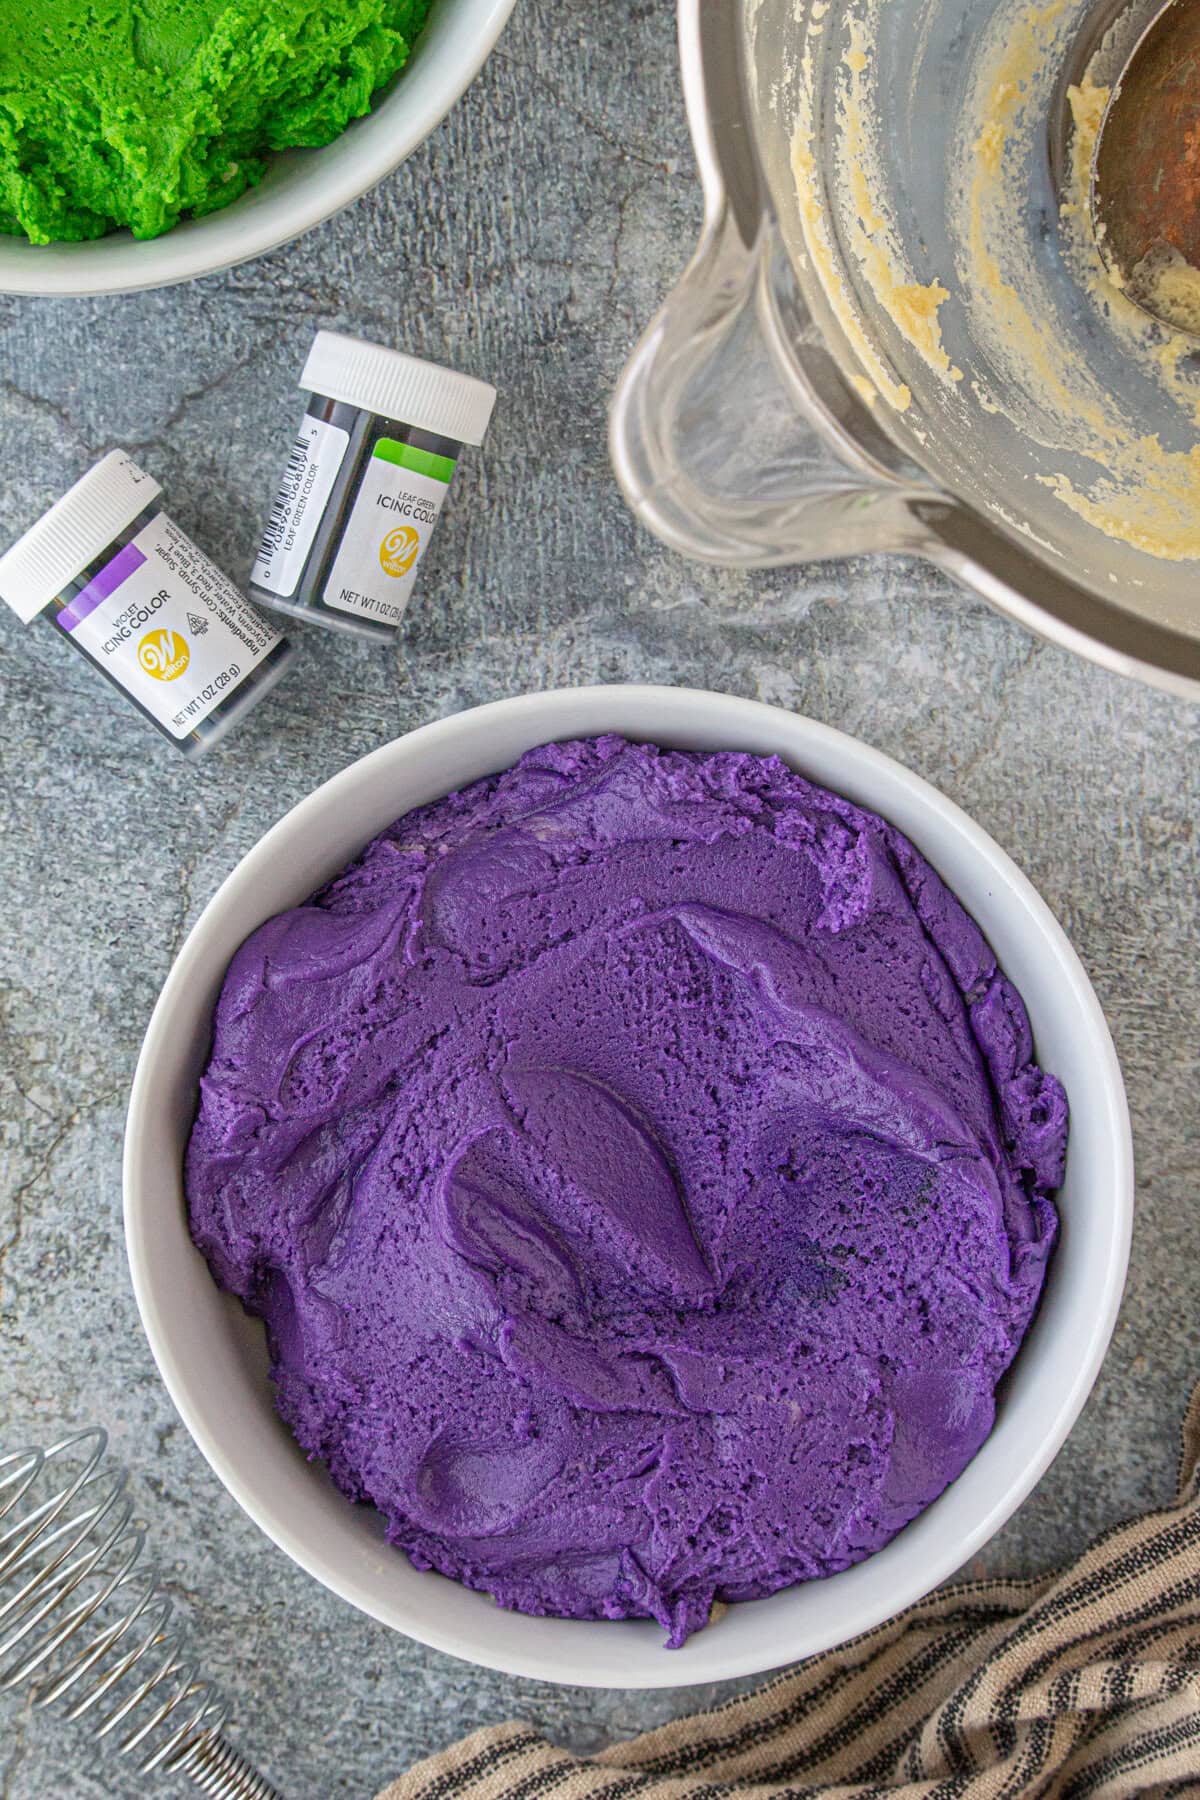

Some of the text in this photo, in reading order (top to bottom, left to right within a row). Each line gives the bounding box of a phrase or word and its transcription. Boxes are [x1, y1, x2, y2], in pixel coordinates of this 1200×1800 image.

[283, 463, 319, 552] LEAF GREEN COLOR
[376, 494, 412, 516] ICING
[398, 491, 417, 503] LEAF
[264, 570, 271, 579] 0
[272, 507, 292, 552] 70896
[289, 454, 309, 501] 06809
[152, 542, 179, 571] Sugar,
[172, 548, 191, 568] Blue
[175, 566, 201, 594] Syrup,
[196, 573, 213, 591] Red
[222, 588, 243, 610] Food
[339, 589, 360, 605] NET
[360, 596, 375, 610] WT
[379, 602, 391, 615] OZ
[101, 628, 132, 655] ICING
[129, 589, 172, 630] COLOR
[112, 602, 139, 629] VIOLET
[215, 607, 260, 656] Ingredients:
[160, 655, 189, 680] wilton
[172, 711, 188, 728] NET
[184, 700, 201, 716] WT
[202, 684, 218, 700] OZ
[214, 671, 232, 690] (28
